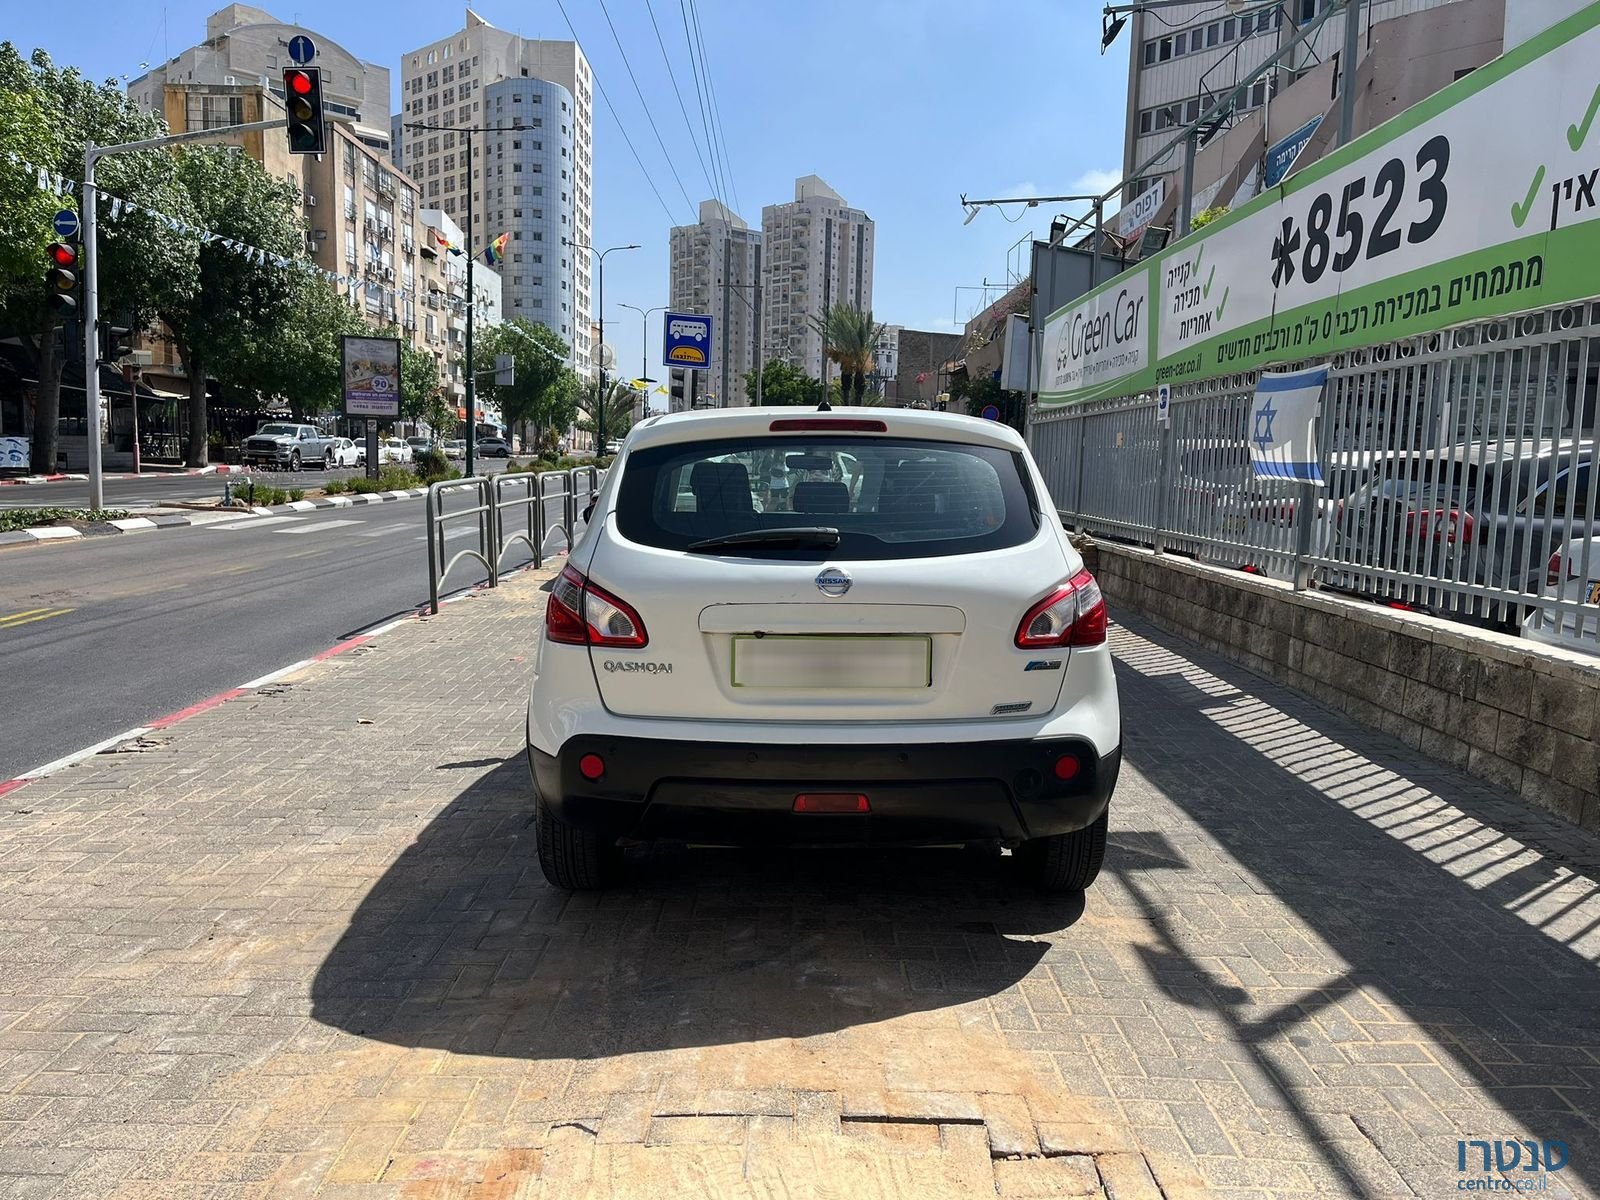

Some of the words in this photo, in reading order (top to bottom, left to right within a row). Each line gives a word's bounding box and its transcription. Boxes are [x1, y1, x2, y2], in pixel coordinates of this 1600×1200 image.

[1135, 189, 1159, 218] דפוס
[1551, 167, 1600, 231] אין
[1167, 260, 1191, 288] קנייה
[1448, 255, 1543, 307] מתמחים
[1173, 285, 1200, 314] מכירה
[1372, 284, 1441, 327] במכירת
[1071, 313, 1110, 360] Green
[1114, 289, 1143, 344] Car
[1179, 311, 1212, 340] אחריות
[1322, 311, 1332, 339] 0
[1336, 305, 1368, 335] רכבי
[1217, 337, 1251, 363] חדשים
[1253, 326, 1290, 355] ורכבים
[1155, 353, 1202, 384] green-car.co.il
[374, 380, 387, 389] 90
[818, 577, 850, 585] NISSAN
[603, 660, 673, 674] QASHQAI
